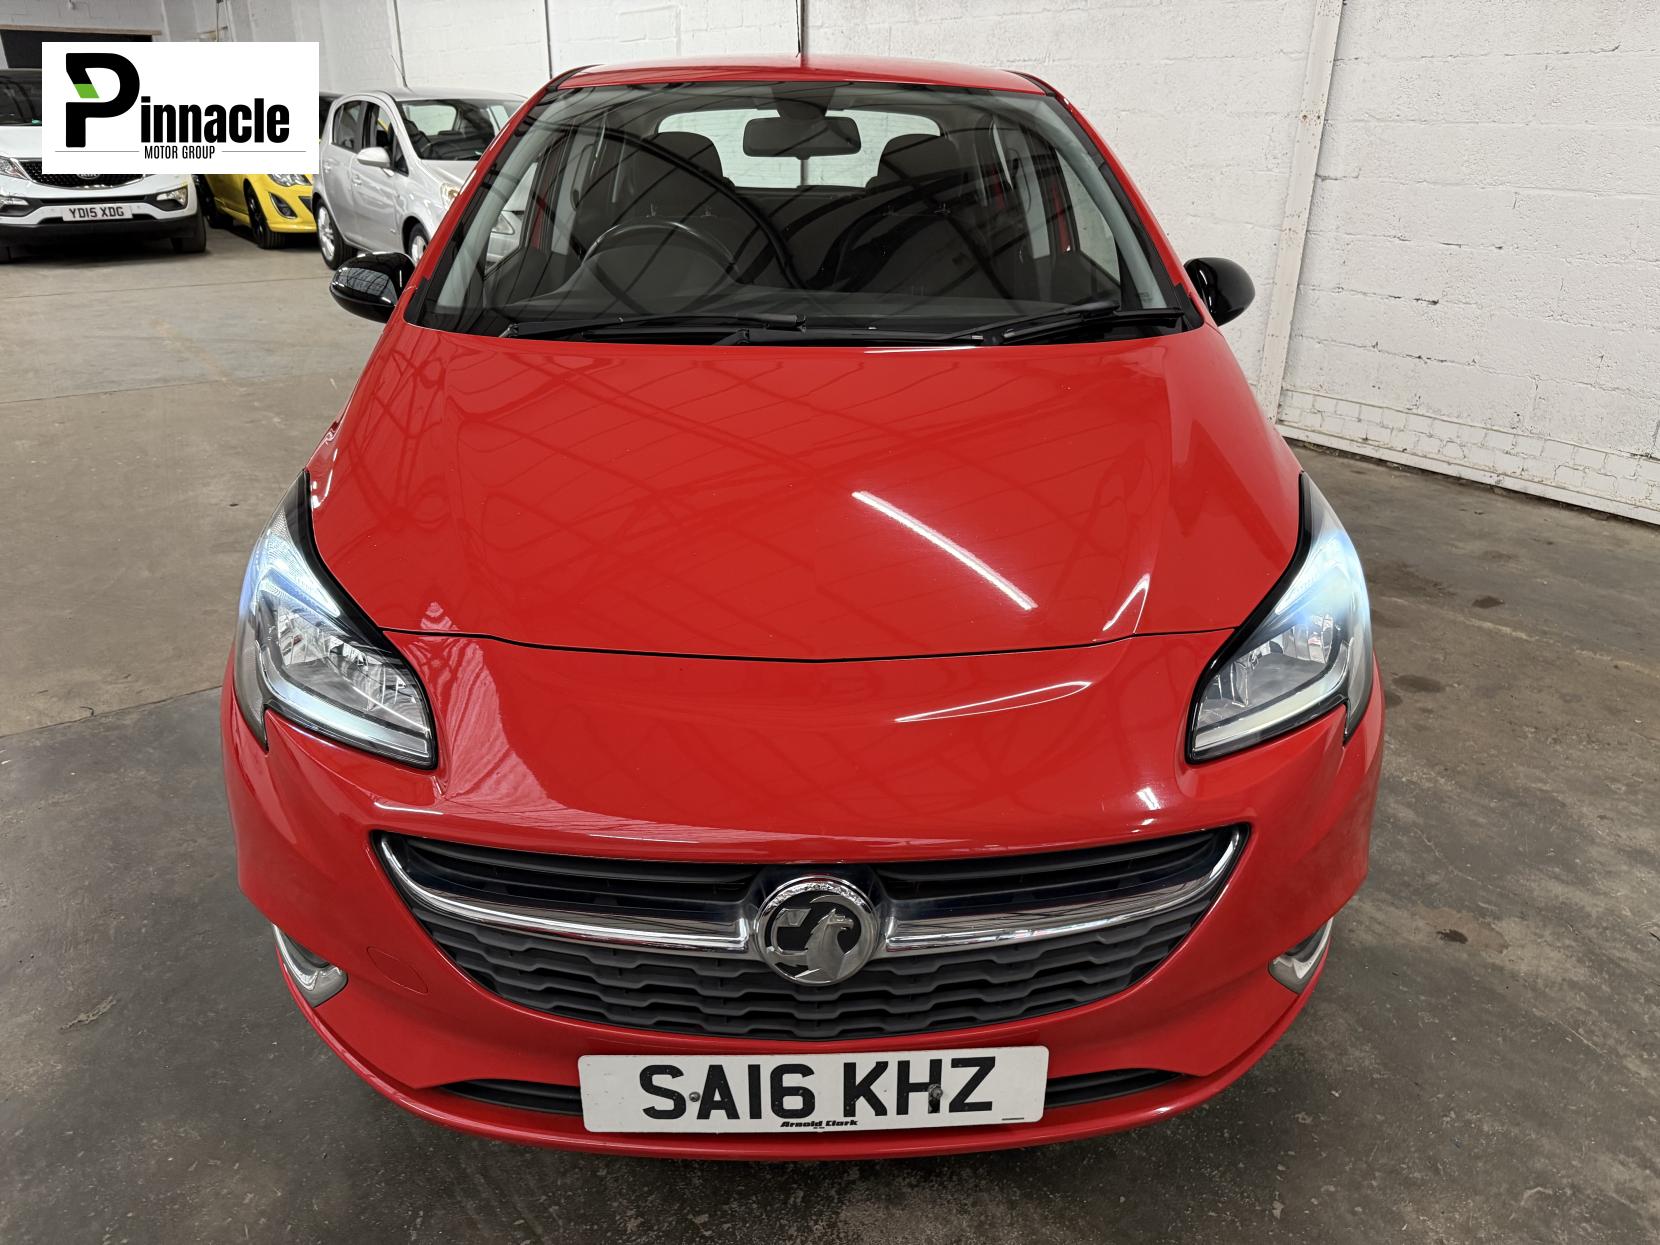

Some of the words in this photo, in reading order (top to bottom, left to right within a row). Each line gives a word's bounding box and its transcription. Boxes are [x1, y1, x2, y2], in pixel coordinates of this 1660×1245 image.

[68, 206, 98, 219] YD15
[101, 206, 125, 218] XDG
[639, 1064, 816, 1120] SA16
[843, 1056, 996, 1118] KHZ
[780, 1120, 823, 1128] Arnold
[825, 1119, 858, 1127] Clark
